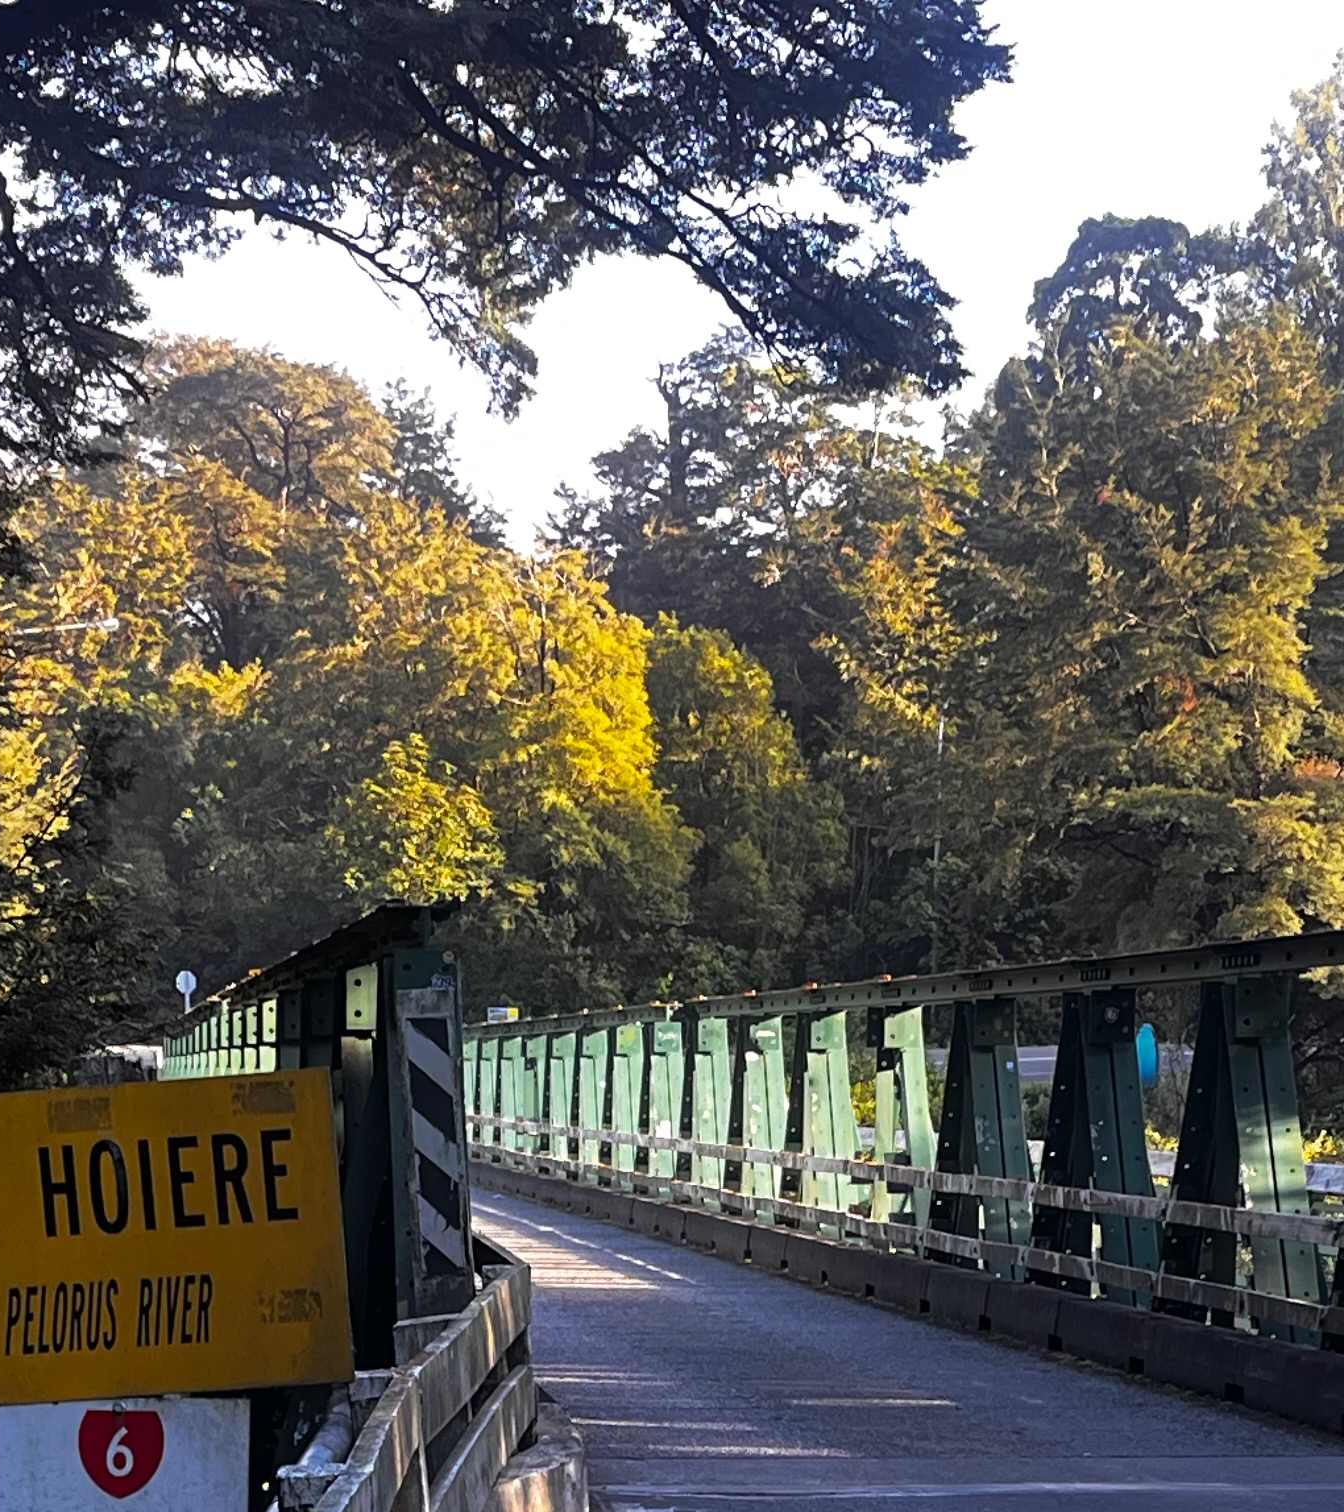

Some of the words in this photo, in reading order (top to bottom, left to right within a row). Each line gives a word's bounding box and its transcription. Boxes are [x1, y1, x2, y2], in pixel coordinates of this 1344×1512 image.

[37, 1128, 299, 1238] HOIERE
[4, 1278, 119, 1357] PELORUS
[136, 1274, 213, 1348] RIVER
[106, 1426, 134, 1477] 6
